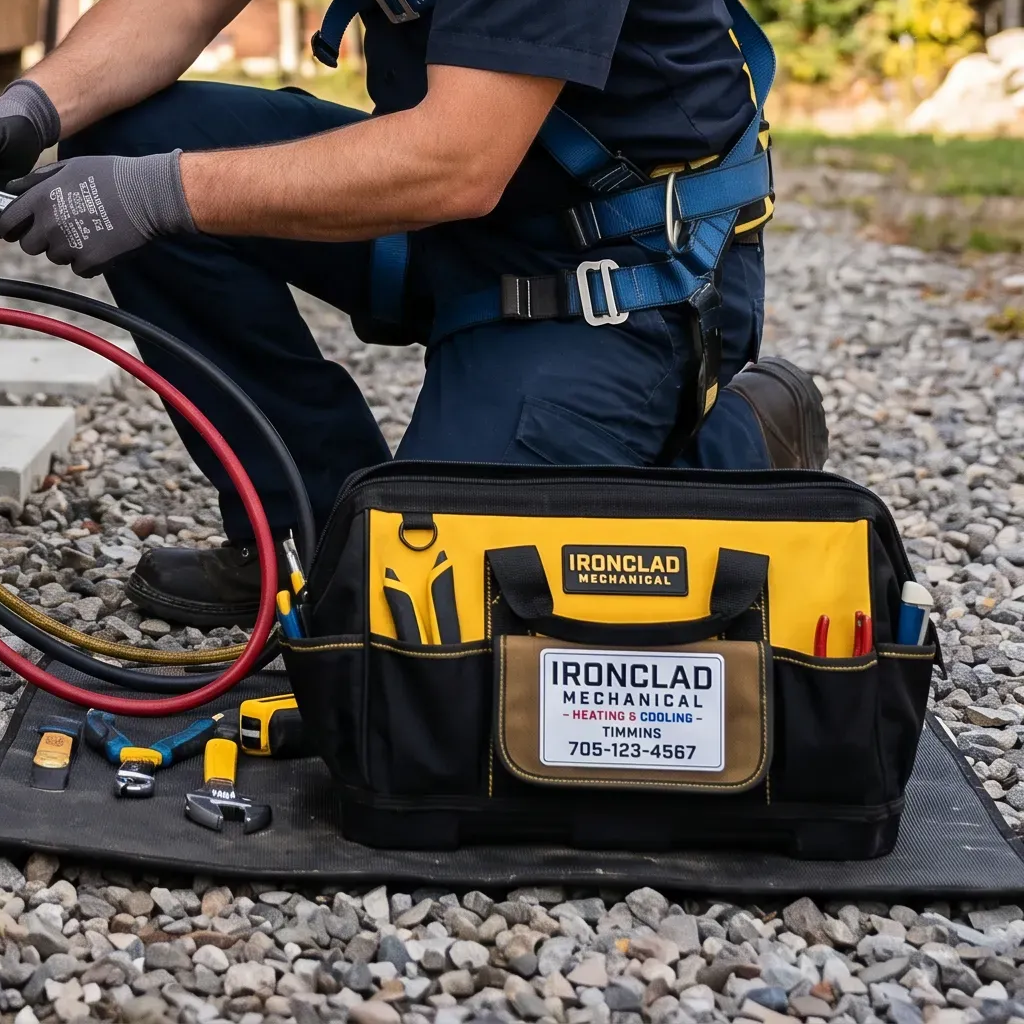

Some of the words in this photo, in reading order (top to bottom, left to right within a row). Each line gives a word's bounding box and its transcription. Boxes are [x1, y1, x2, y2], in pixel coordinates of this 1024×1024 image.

[569, 553, 680, 573] IRONCLAD
[578, 574, 672, 586] MECHANICAL
[552, 661, 712, 690] IRONCLAD
[563, 691, 703, 708] MECHANICAL
[572, 710, 625, 721] HEATING
[602, 726, 662, 739] TIMMINS
[568, 741, 697, 760] 705-123-4567
